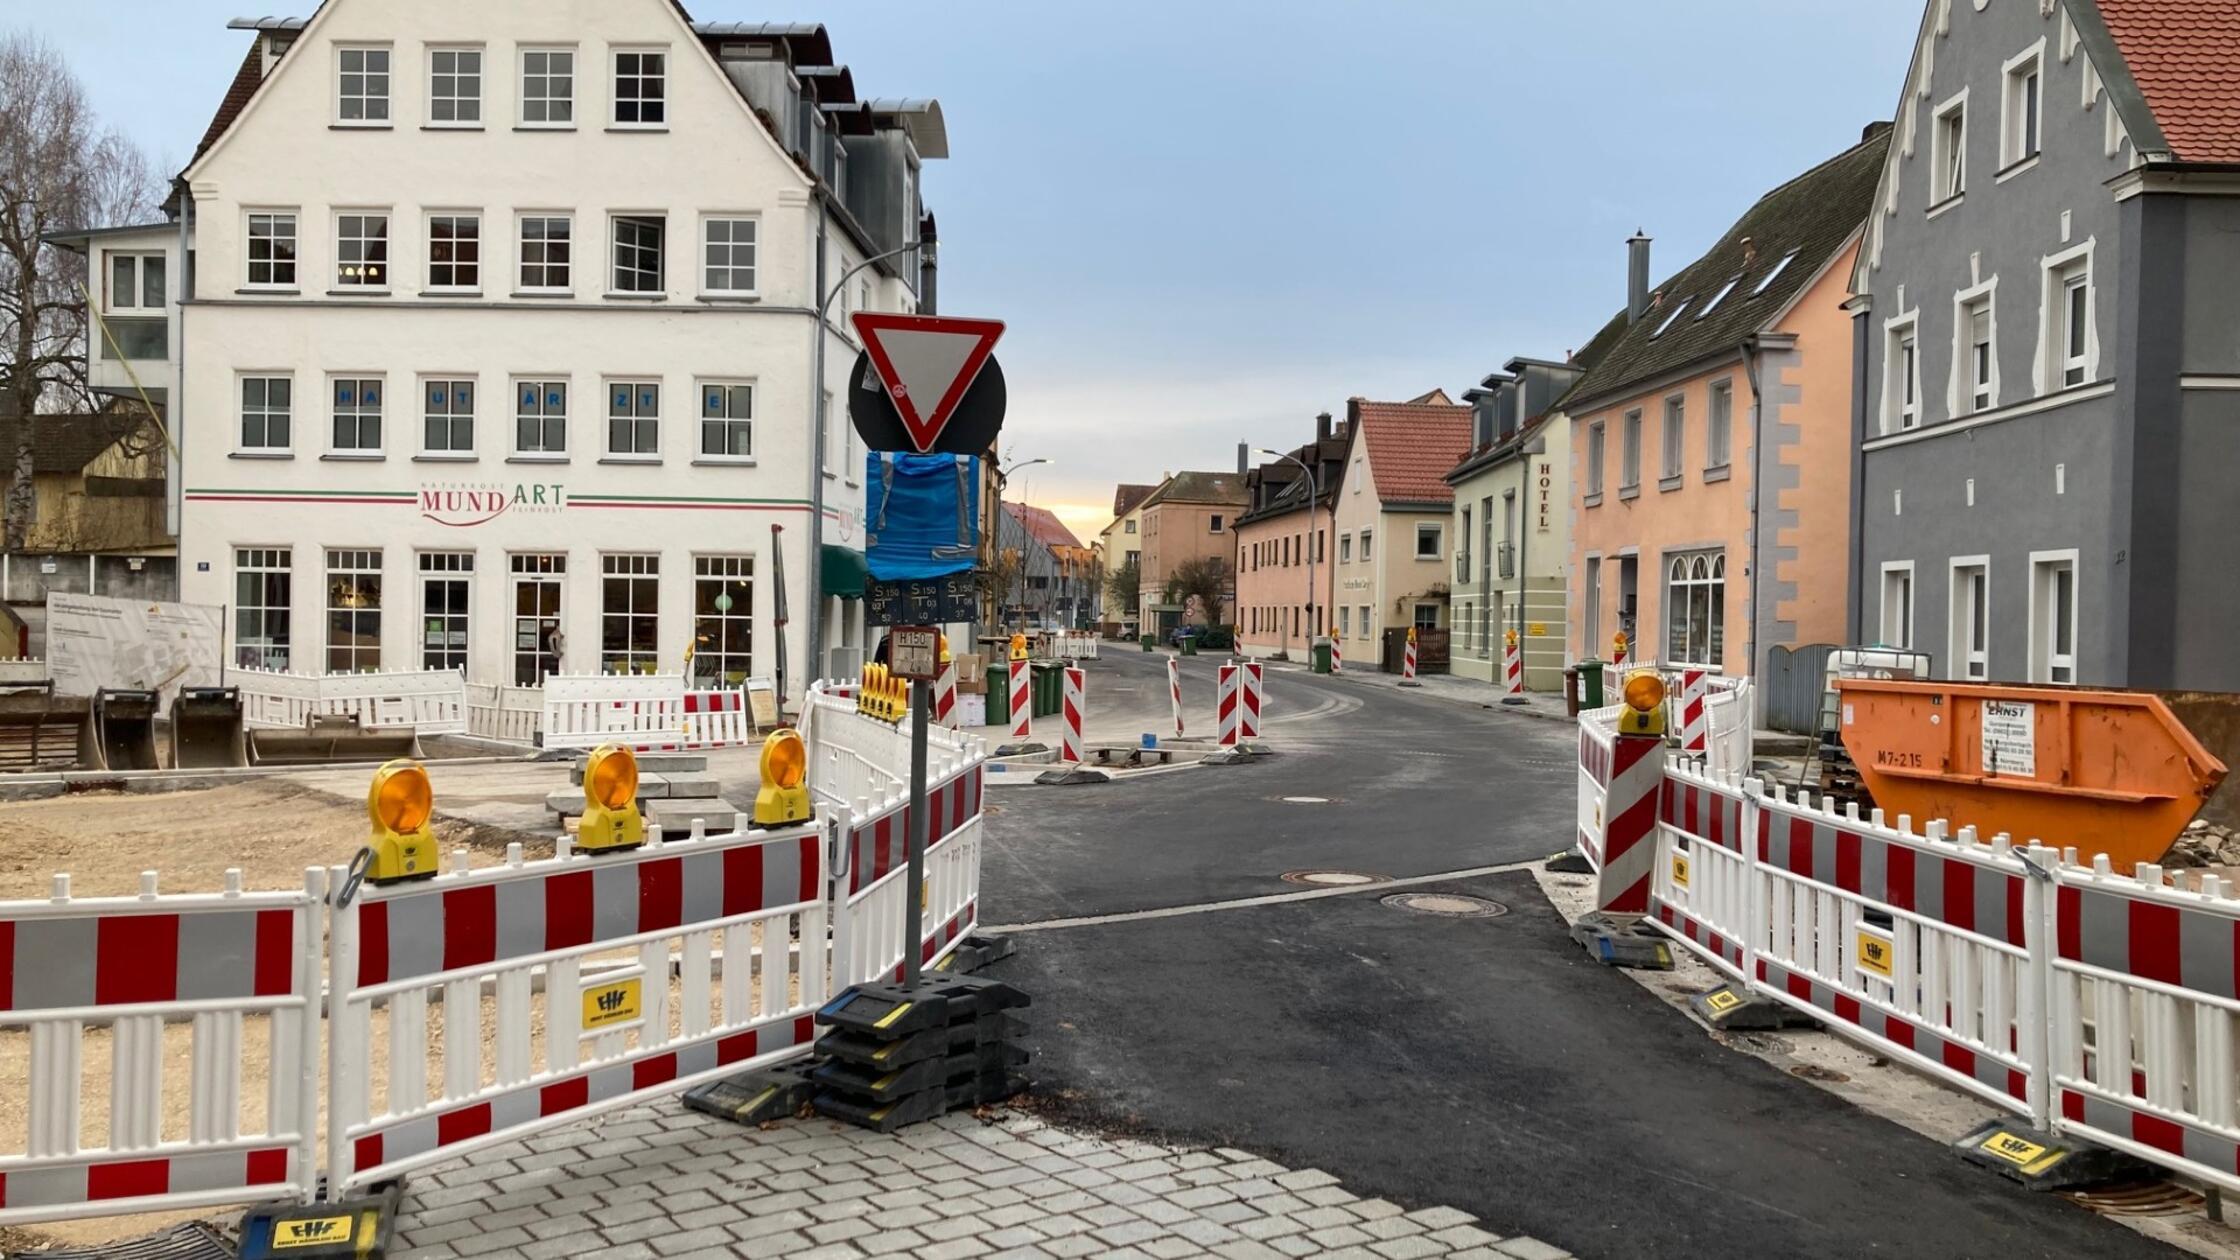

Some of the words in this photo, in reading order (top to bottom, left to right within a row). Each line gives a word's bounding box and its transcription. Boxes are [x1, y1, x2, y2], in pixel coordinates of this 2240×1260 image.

[1539, 463, 1551, 527] HOTEL
[1988, 705, 2026, 718] ERNST
[290, 1221, 338, 1237] EHF
